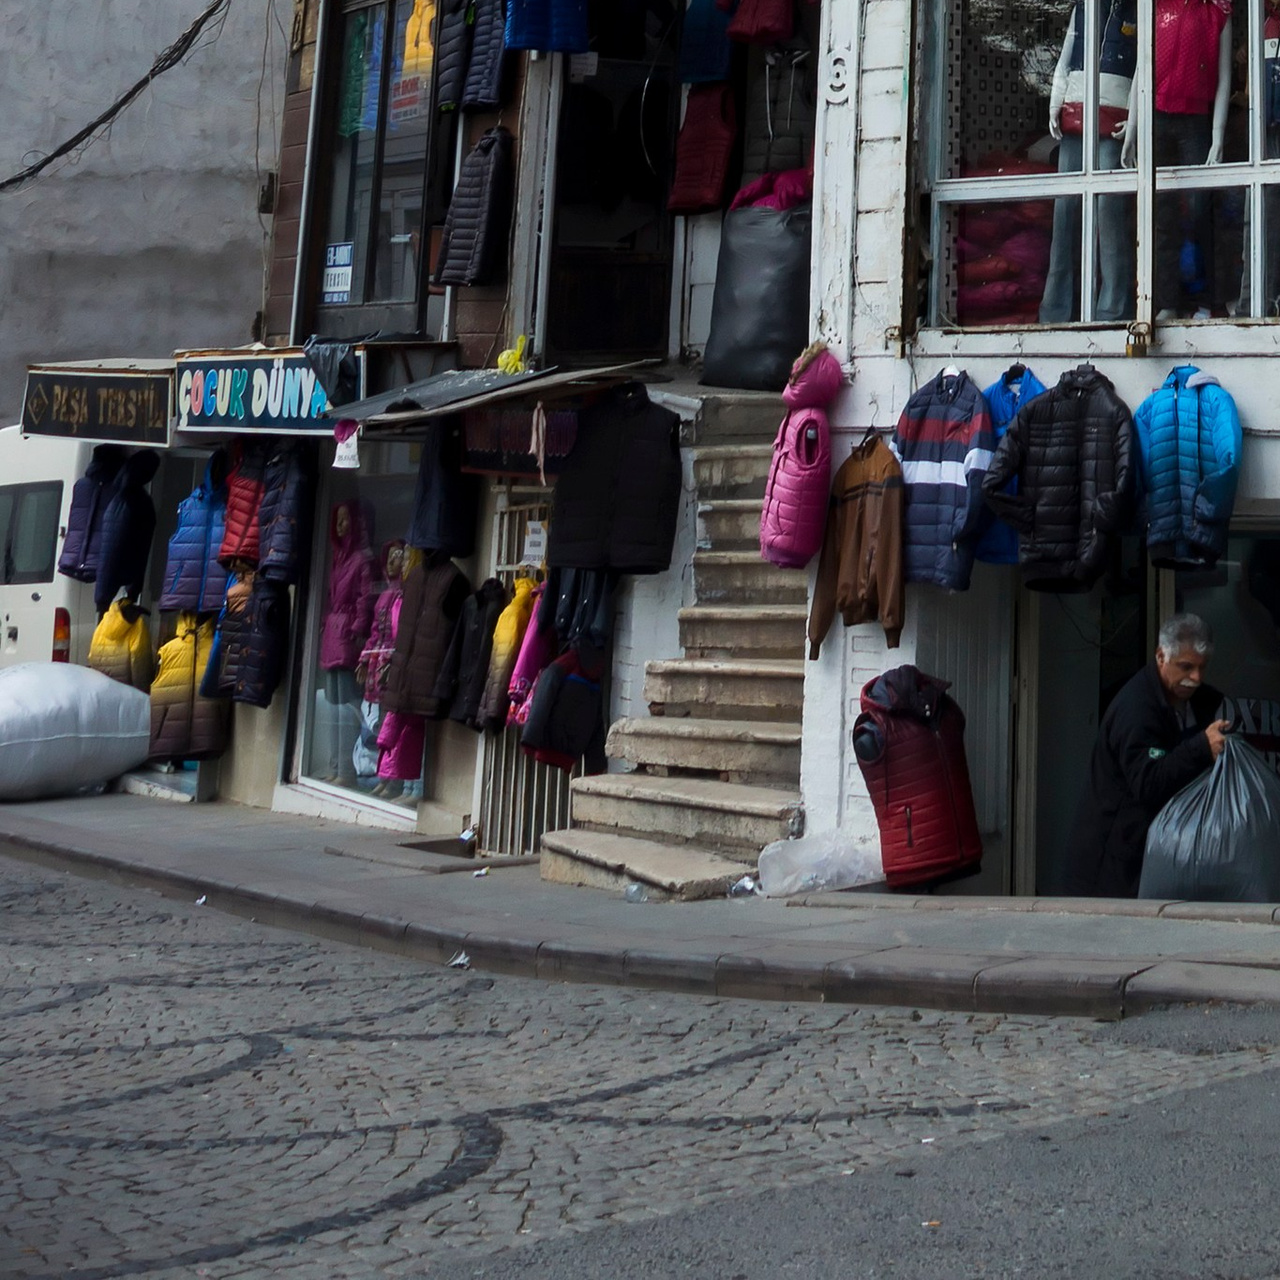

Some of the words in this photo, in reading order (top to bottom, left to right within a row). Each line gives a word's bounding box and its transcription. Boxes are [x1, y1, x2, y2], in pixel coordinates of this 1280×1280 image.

[52, 384, 89, 433] PAŞA
[179, 368, 248, 427] ÇOCUK
[251, 358, 330, 419] DÜNYA
